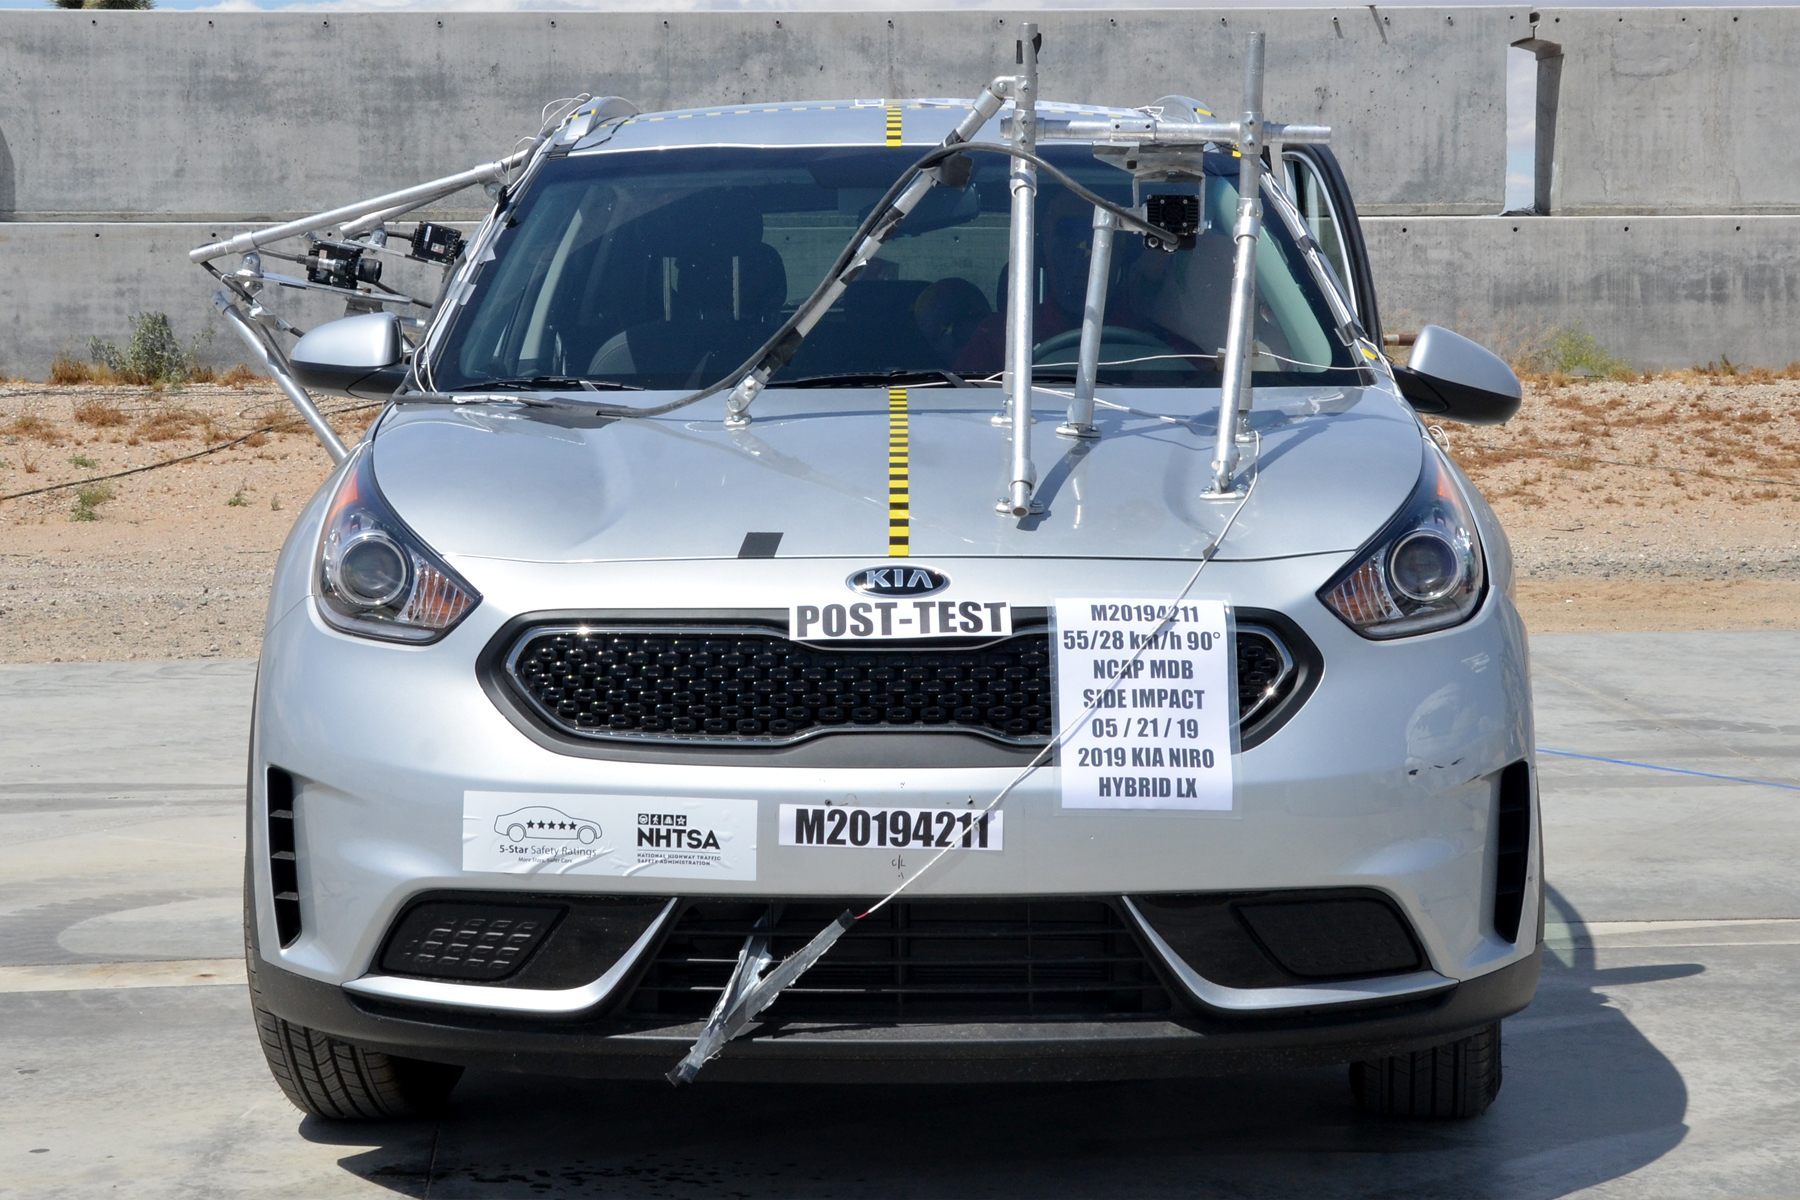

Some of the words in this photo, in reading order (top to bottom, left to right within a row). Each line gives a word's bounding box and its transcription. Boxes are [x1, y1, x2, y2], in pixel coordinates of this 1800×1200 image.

[865, 569, 934, 589] KIA
[797, 601, 1007, 638] POST-TEST
[1091, 604, 1199, 623] M20194211
[1063, 630, 1124, 650] 55/28
[1129, 630, 1182, 650] km/h
[1187, 631, 1221, 651] 90°
[1093, 659, 1145, 680] NCAP
[1150, 660, 1194, 680] MDB
[1083, 689, 1127, 709] SIDE
[1131, 689, 1205, 709] IMPACT
[1092, 718, 1118, 738] 05
[1123, 718, 1132, 738] /
[1137, 718, 1159, 738] 21
[1163, 718, 1172, 738] /
[1177, 719, 1199, 739] 19
[1078, 747, 1126, 767] 2019
[1132, 748, 1165, 767] KIA
[1169, 748, 1215, 768] NIRO
[1099, 777, 1171, 797] HYBRID
[1176, 777, 1198, 798] LX
[637, 827, 721, 850] NHTSA
[795, 808, 989, 848] M20194211
[499, 844, 529, 854] 5-Star
[530, 845, 560, 857] Safety
[561, 846, 597, 858] Ratings
